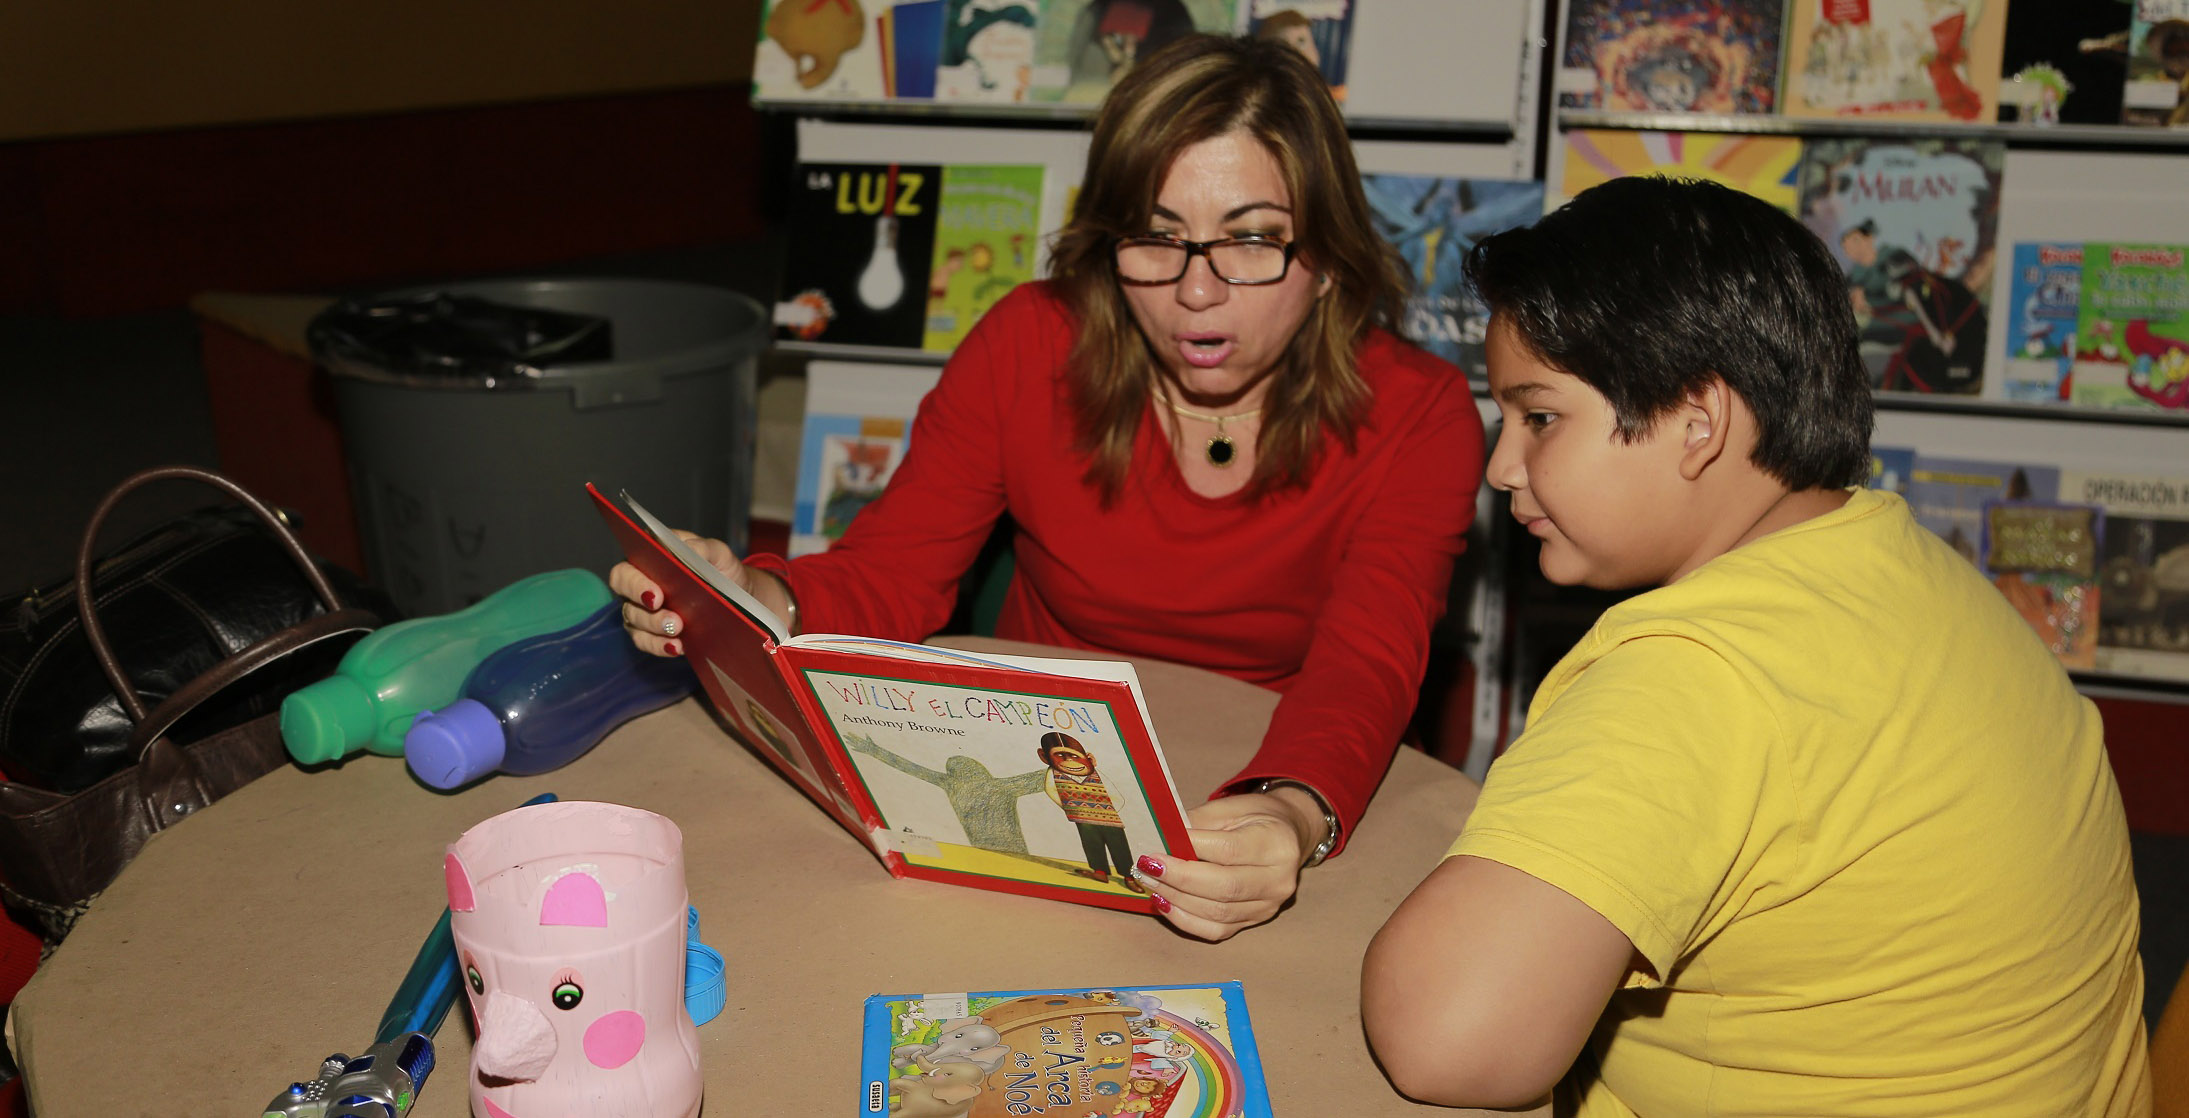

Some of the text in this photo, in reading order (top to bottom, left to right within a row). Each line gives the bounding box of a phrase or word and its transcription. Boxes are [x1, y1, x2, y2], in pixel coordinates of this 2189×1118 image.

[807, 172, 832, 190] LA
[836, 172, 924, 216] LUZ
[1851, 169, 1957, 204] MULAN
[842, 713, 966, 737] Anthony Browne
[928, 698, 963, 718] EL
[965, 696, 1099, 734] CAMPEÓN
[1040, 1026, 1086, 1108] del Arca
[1067, 1014, 1096, 1103] Pequeña historia
[871, 1083, 881, 1109] susaeta
[1003, 1051, 1045, 1116] de Noé
